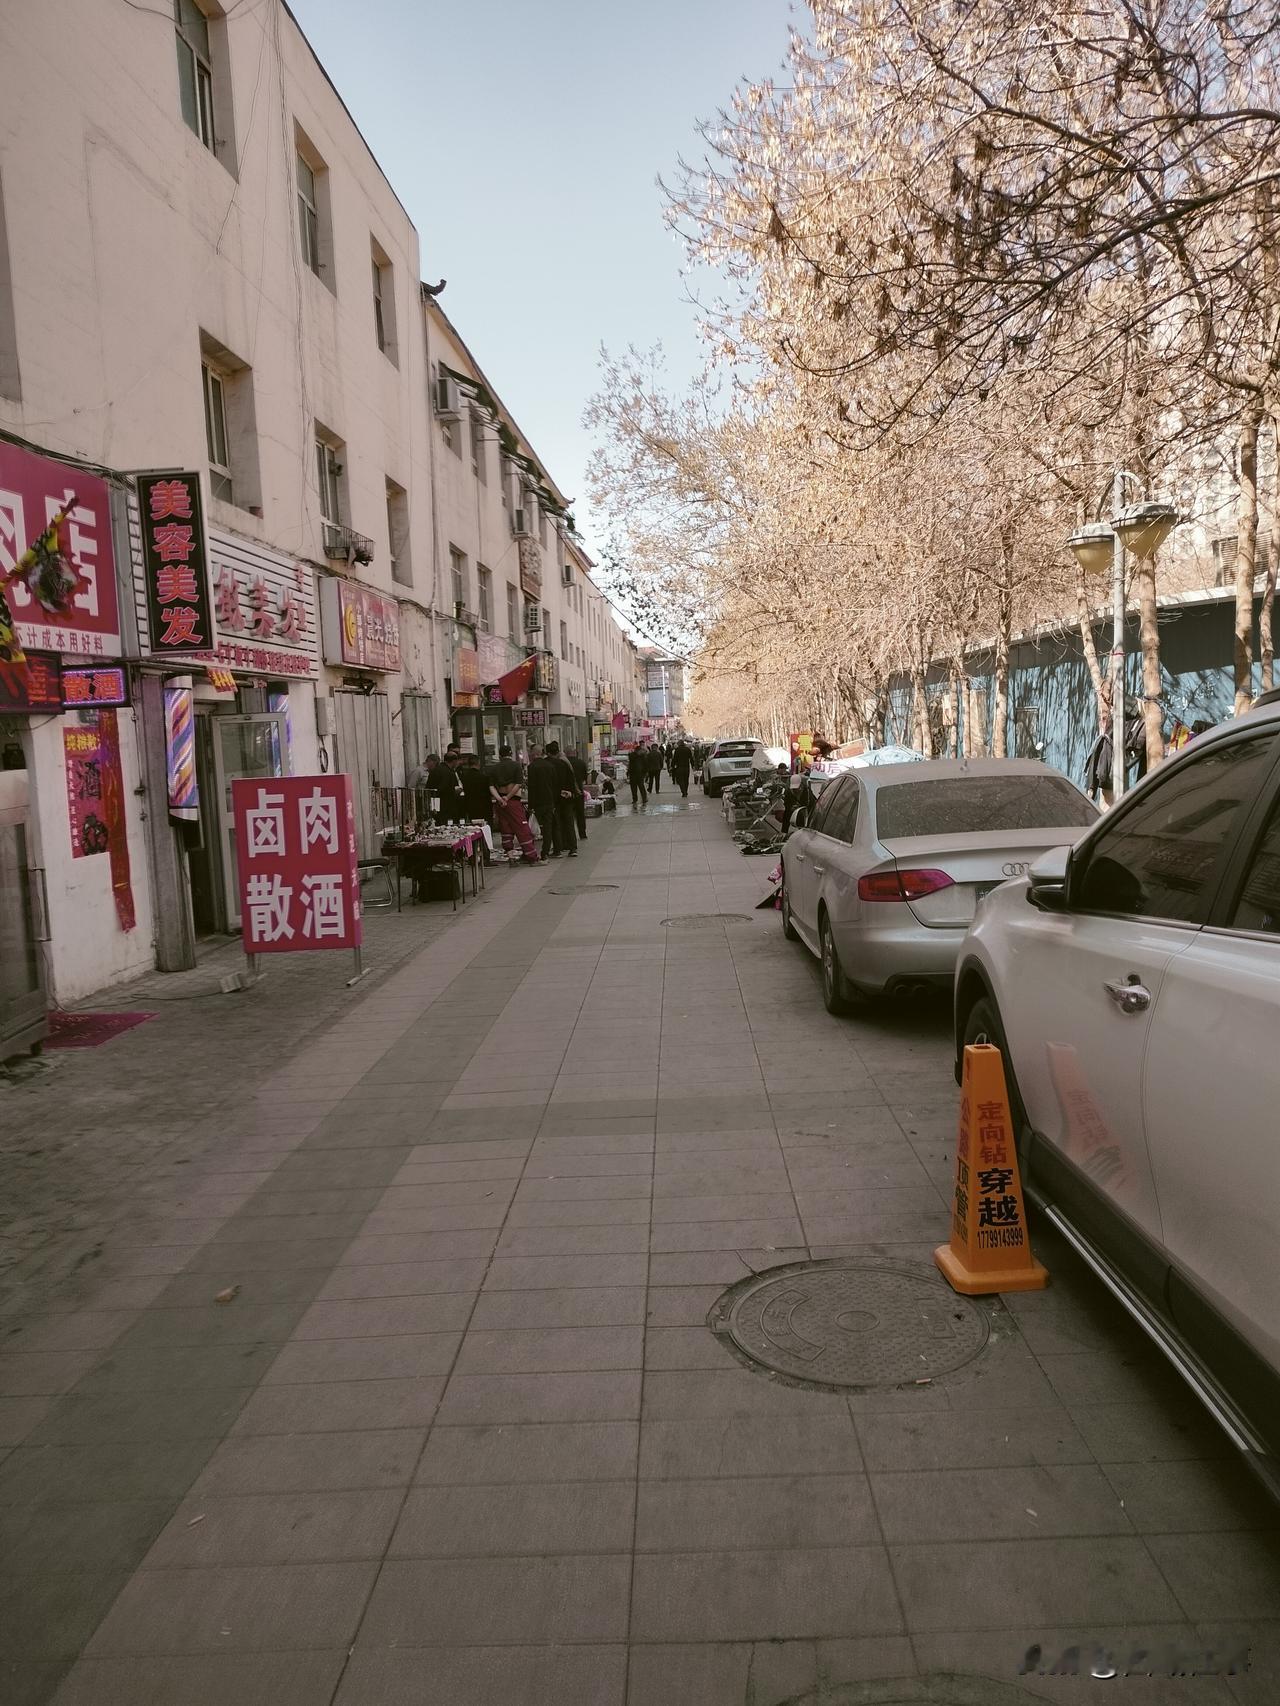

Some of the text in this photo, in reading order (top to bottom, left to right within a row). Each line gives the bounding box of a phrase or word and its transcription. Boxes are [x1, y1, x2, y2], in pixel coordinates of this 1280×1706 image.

[150, 480, 203, 645] 美容美发
[62, 674, 121, 701] 散酒
[245, 787, 339, 858] 卤肉
[246, 873, 345, 943] 散酒
[976, 1227, 1024, 1249] 17799143999
